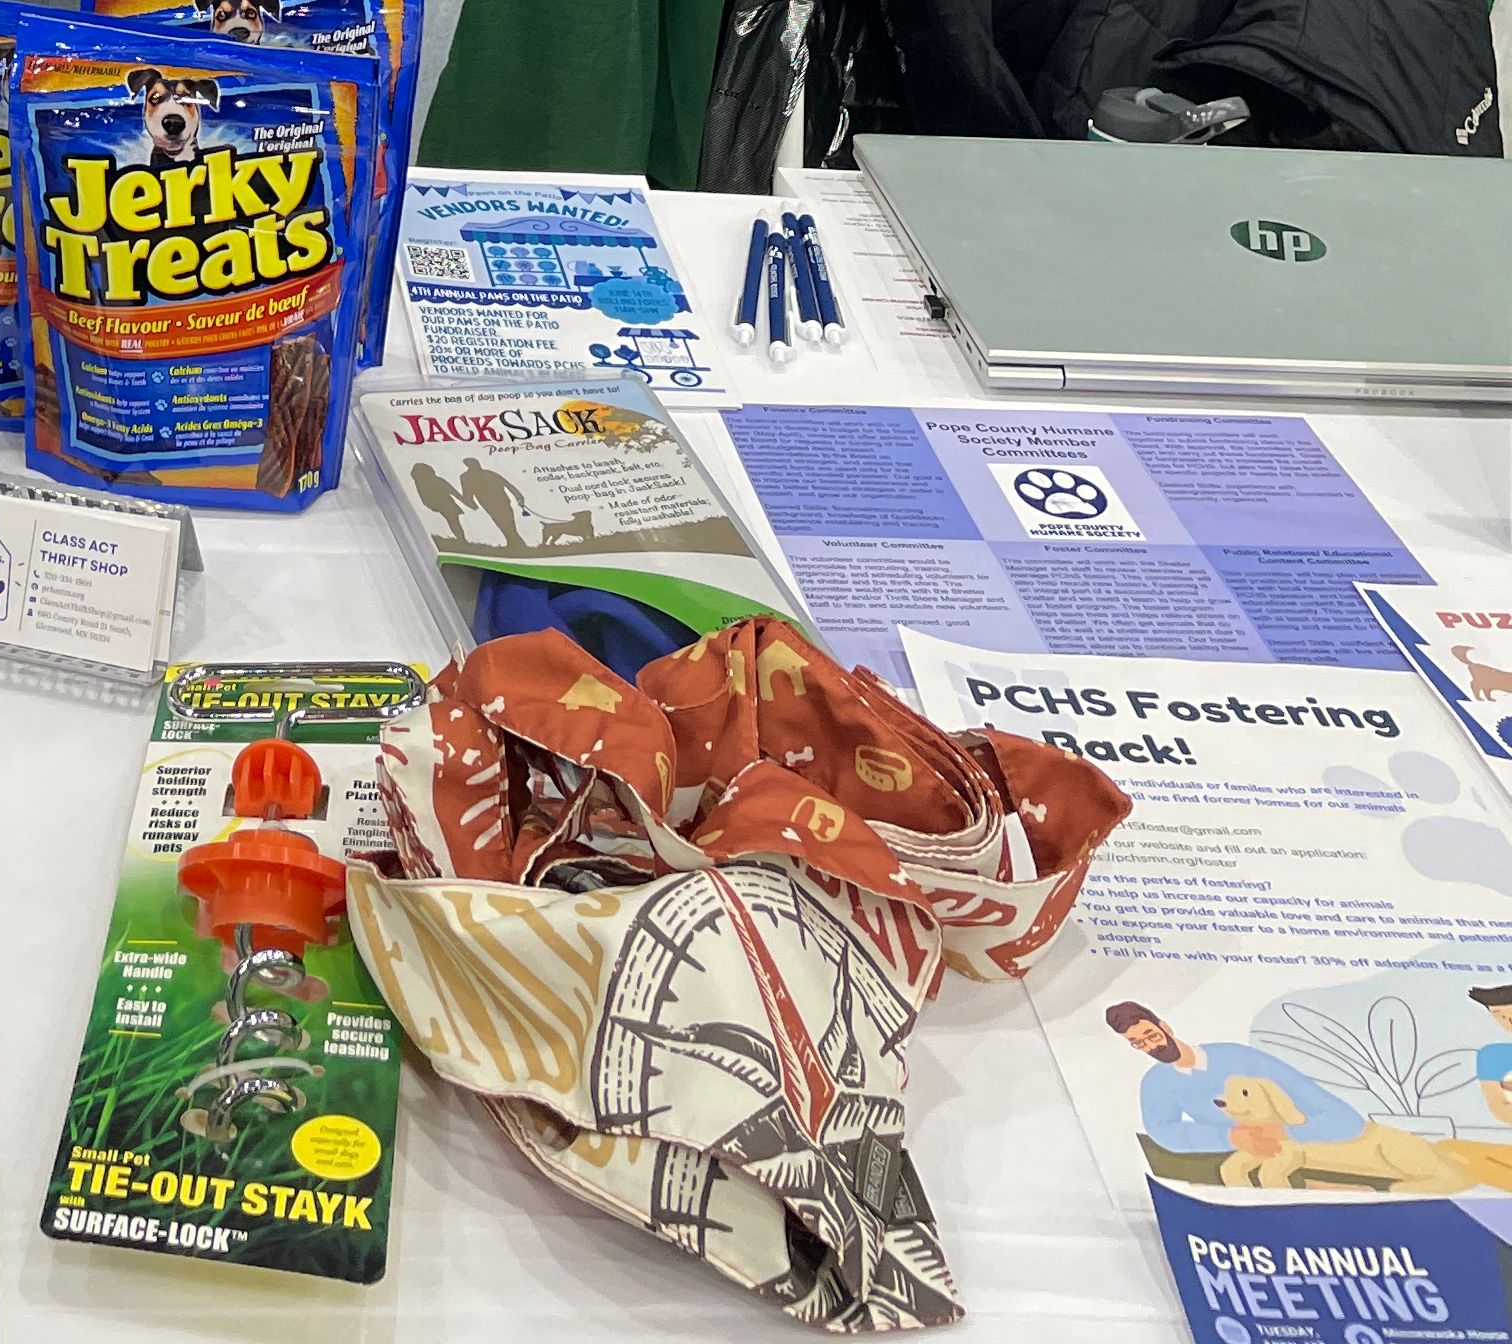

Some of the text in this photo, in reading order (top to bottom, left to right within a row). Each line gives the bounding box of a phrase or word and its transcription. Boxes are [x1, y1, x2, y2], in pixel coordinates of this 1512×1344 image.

[312, 21, 375, 45] The Original
[254, 121, 324, 140] The Original
[50, 150, 317, 232] Jerky
[416, 200, 630, 229] VENDORS WANTED!
[1248, 220, 1312, 262] hp
[46, 211, 328, 300] Treats
[411, 286, 582, 304] 4TH ANNUAL PAWS ON THE PATIO
[69, 285, 310, 334] Beef Flavour Saveur de bœuf
[419, 307, 474, 316] VENDORS
[477, 309, 523, 318] WANTED
[120, 339, 143, 350] REAL
[427, 336, 556, 349] $20 REGISTRATION FEE
[390, 396, 424, 407] Carries
[426, 396, 442, 405] the
[444, 394, 462, 405] bag
[465, 394, 476, 402] of
[478, 393, 495, 403] dog
[497, 391, 521, 403] poop
[536, 391, 554, 400] you
[556, 387, 581, 397] don't
[583, 387, 604, 396] have
[606, 385, 620, 394] to!
[926, 421, 1114, 439] Pope County Humane
[555, 438, 605, 448] Carrier
[958, 434, 1097, 448] Society Member
[982, 446, 1088, 460] Committees
[42, 530, 118, 555] CLASS ACT
[40, 550, 128, 576] THRIFT SHOP
[966, 677, 1401, 738] PCHS Fostering
[156, 766, 212, 776] Superior
[157, 776, 206, 786] holding
[152, 787, 207, 796] strength
[150, 808, 199, 817] Reduce
[148, 819, 197, 828] risks of
[142, 831, 199, 841] runaway
[153, 843, 182, 853] pets
[1088, 873, 1272, 891] are the perks of fostering?
[114, 951, 187, 966] Extra-wide
[122, 966, 172, 980] Handle
[116, 998, 166, 1012] Easy to
[116, 1012, 162, 1028] install
[327, 1012, 391, 1030] Provides
[332, 1028, 384, 1044] secure
[324, 1042, 389, 1060] leashing
[71, 1145, 150, 1166] Small Pet
[60, 1195, 85, 1208] with
[67, 1161, 373, 1230] TIE-OUT STAYK
[1188, 1234, 1428, 1278] PCHS ANNUAL
[1197, 1266, 1450, 1322] MEETING
